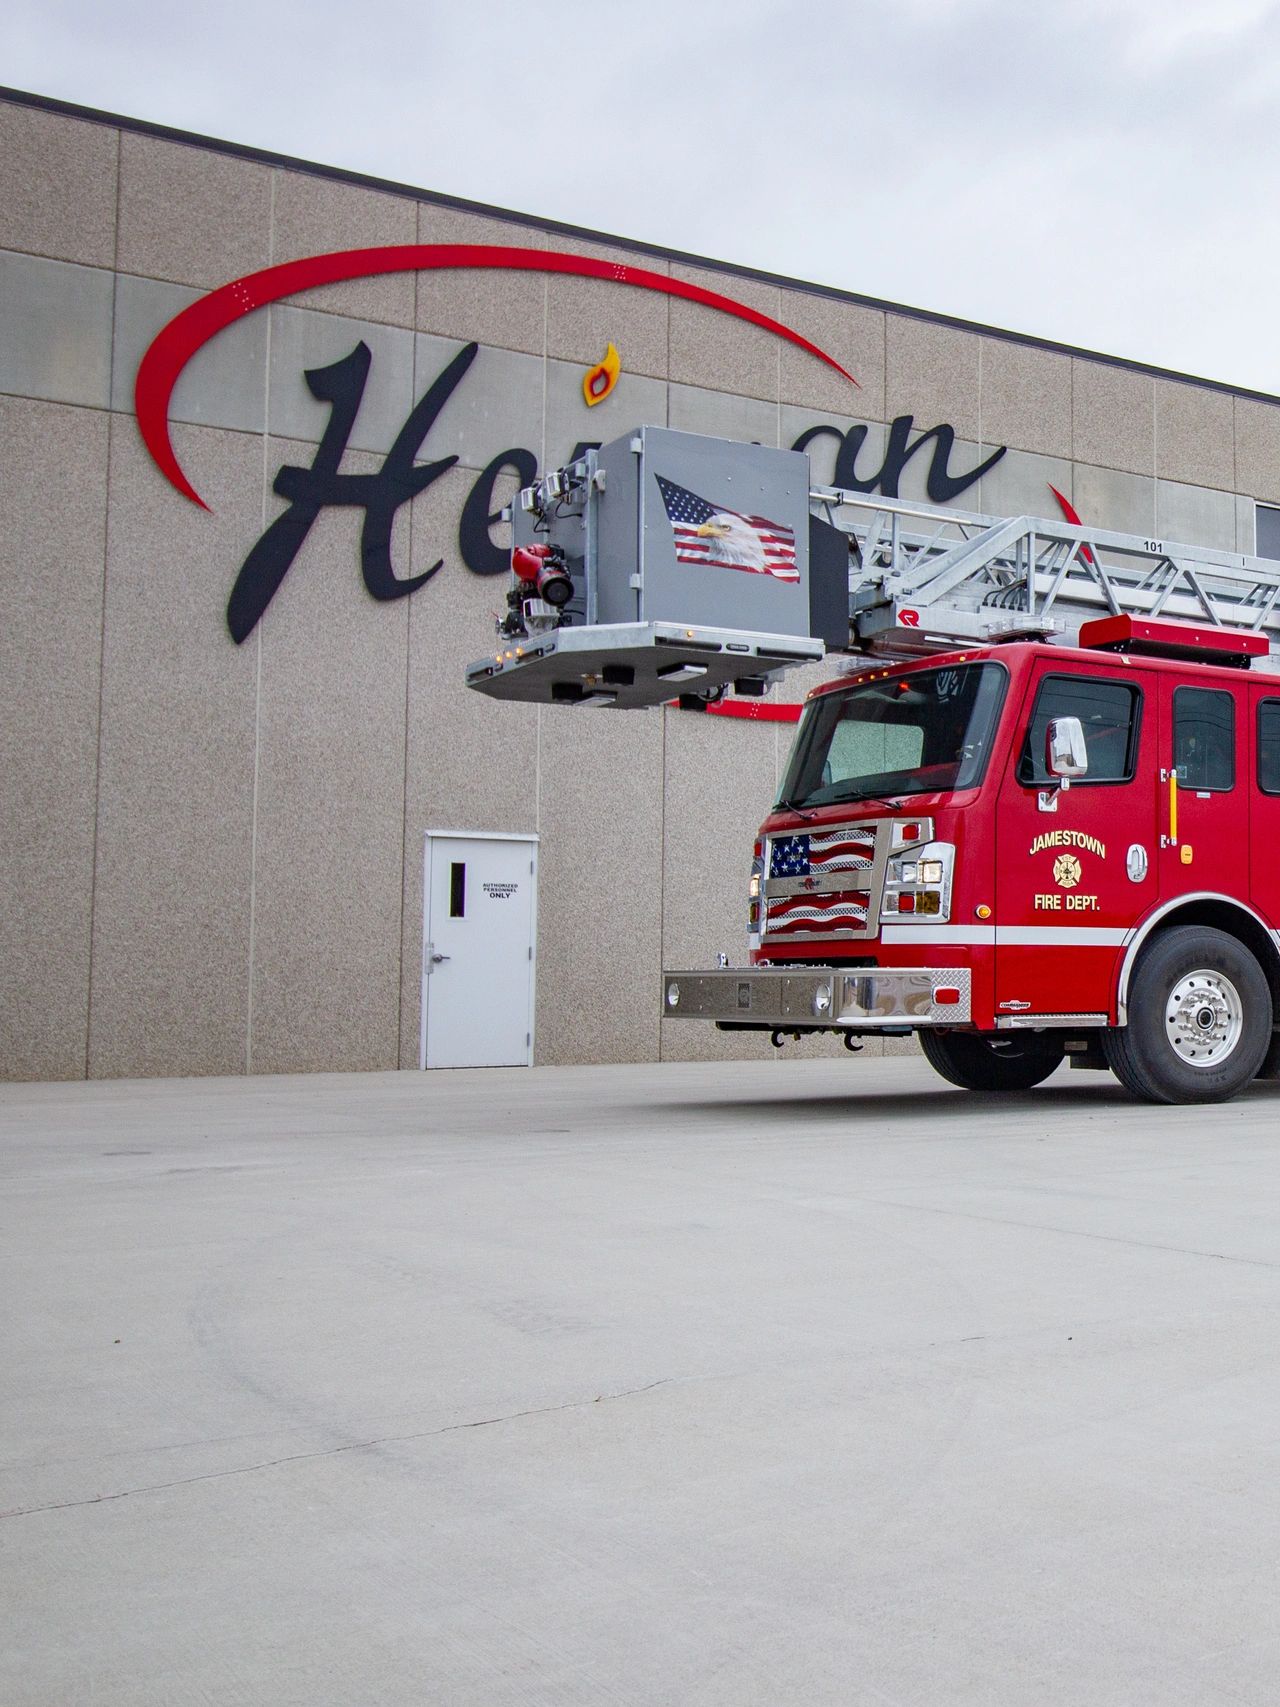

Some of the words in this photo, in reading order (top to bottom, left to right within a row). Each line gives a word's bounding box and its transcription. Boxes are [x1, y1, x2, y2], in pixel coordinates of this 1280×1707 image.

[226, 340, 1007, 645] Hean
[1143, 540, 1162, 553] 101
[1028, 829, 1106, 860] JAMESTOWN
[1034, 893, 1062, 910] FIRE
[1066, 895, 1100, 911] DEPT.
